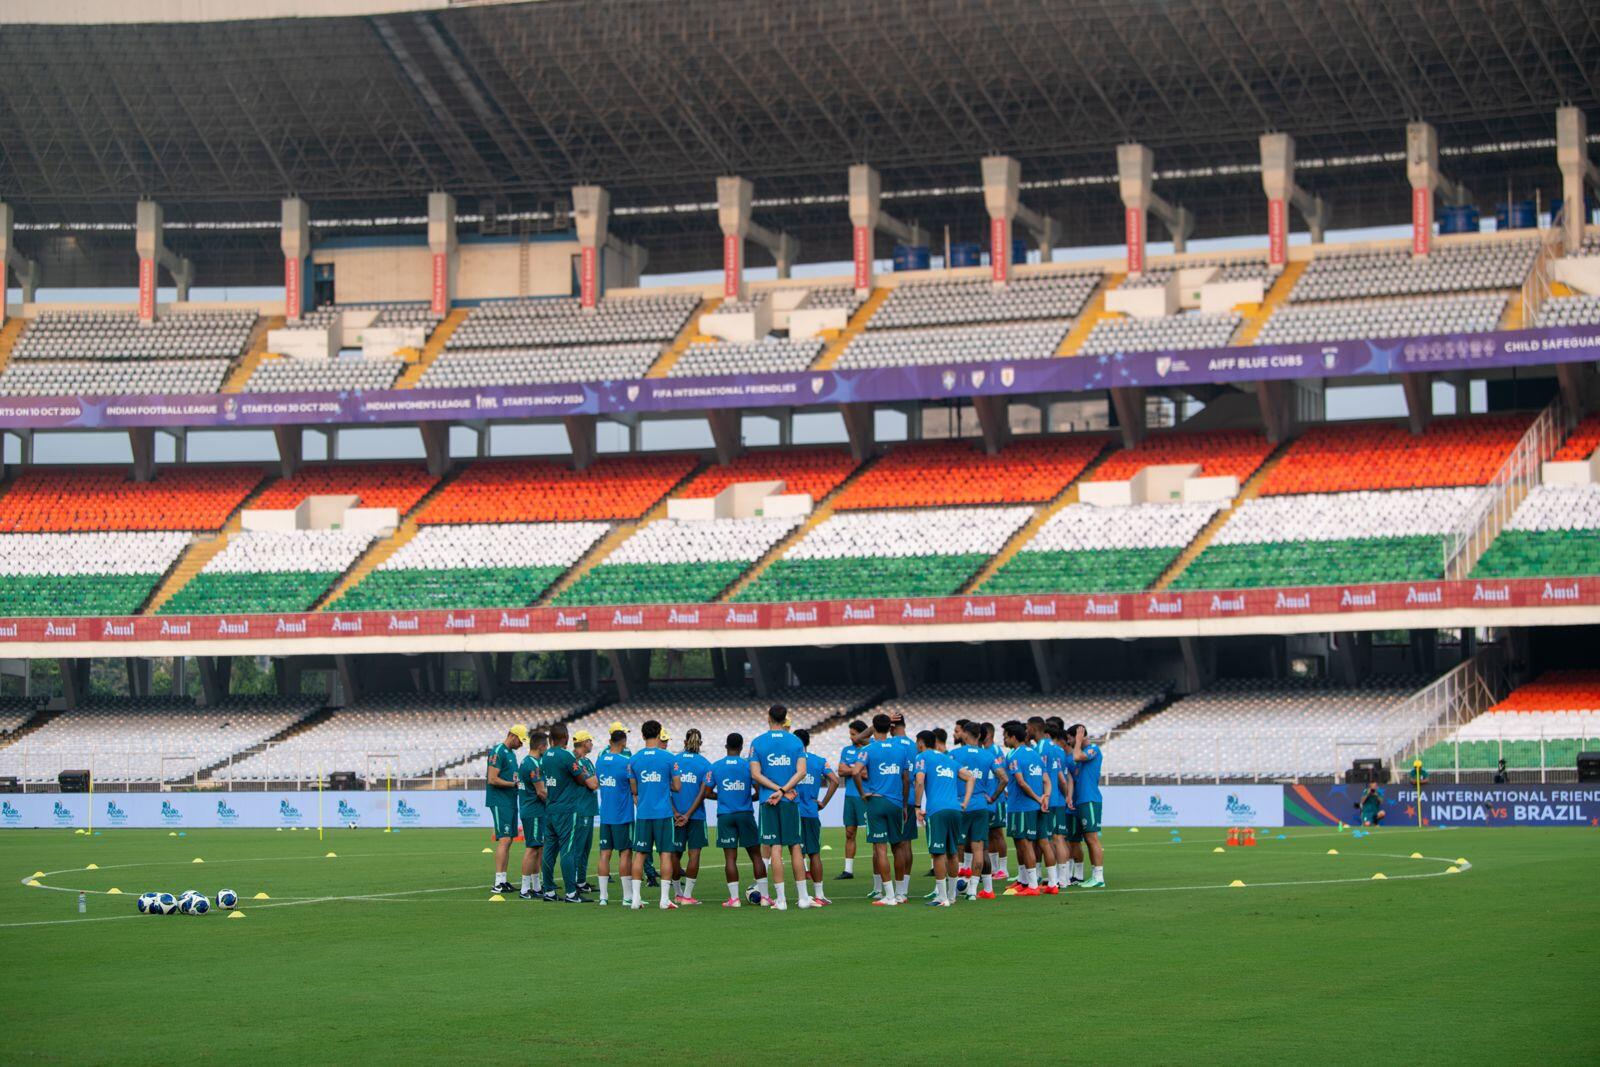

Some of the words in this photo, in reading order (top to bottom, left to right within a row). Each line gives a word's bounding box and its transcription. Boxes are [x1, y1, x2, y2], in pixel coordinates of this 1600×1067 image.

[1504, 341, 1539, 353] CHILD
[1208, 357, 1235, 370] AIFF
[1237, 356, 1268, 369] BLUE
[1269, 355, 1303, 368] CUBS
[652, 389, 672, 398] FIFA
[673, 386, 744, 397] INTERNATIONAL
[745, 384, 797, 395] FRIENDLIES
[242, 404, 273, 414] STARTS
[273, 403, 287, 413] ON
[299, 403, 318, 412] OCT
[366, 401, 396, 411] INDIAN
[437, 399, 470, 409] LEAGUE
[502, 397, 533, 407] STARTS
[533, 396, 543, 406] IN
[543, 396, 563, 405] NOV
[15, 407, 29, 416] ON
[40, 407, 59, 416] OCT
[106, 406, 137, 415] INDIAN
[138, 405, 182, 415] FOOTBALL
[183, 405, 217, 414] LEAGUE
[1341, 590, 1376, 606] Amul
[1406, 587, 1442, 604] Amul
[1474, 584, 1509, 601] Amul
[1542, 583, 1579, 600] Amul
[1023, 599, 1056, 616] Amul
[1085, 599, 1119, 615] Amul
[1148, 597, 1182, 614] Amul
[1212, 595, 1245, 611] Amul
[1276, 592, 1310, 609] Amul
[668, 608, 699, 625] Amul
[725, 607, 758, 624] Amul
[786, 607, 817, 622] Amul
[844, 604, 875, 620] Amul
[902, 603, 935, 619] Amul
[963, 601, 996, 617] Amul
[276, 618, 306, 633] Amul
[332, 616, 362, 631] Amul
[389, 615, 419, 630] Amul
[445, 613, 475, 628] Amul
[500, 612, 530, 628] Amul
[613, 610, 643, 626] Amul
[45, 622, 76, 636] Amul
[104, 622, 134, 636] Amul
[161, 620, 191, 635] Amul
[218, 619, 249, 634] Amul
[767, 753, 791, 766] Sadia
[879, 762, 900, 775] Sadia
[640, 770, 661, 783] Sadia
[680, 770, 697, 783] adia
[722, 778, 745, 791] Sadia
[1398, 791, 1428, 802] FIFA
[1431, 791, 1547, 803] INTERNATIONAL
[1431, 805, 1487, 821] INDIA
[1491, 808, 1508, 818] VS
[1513, 805, 1587, 821] BRAZIL
